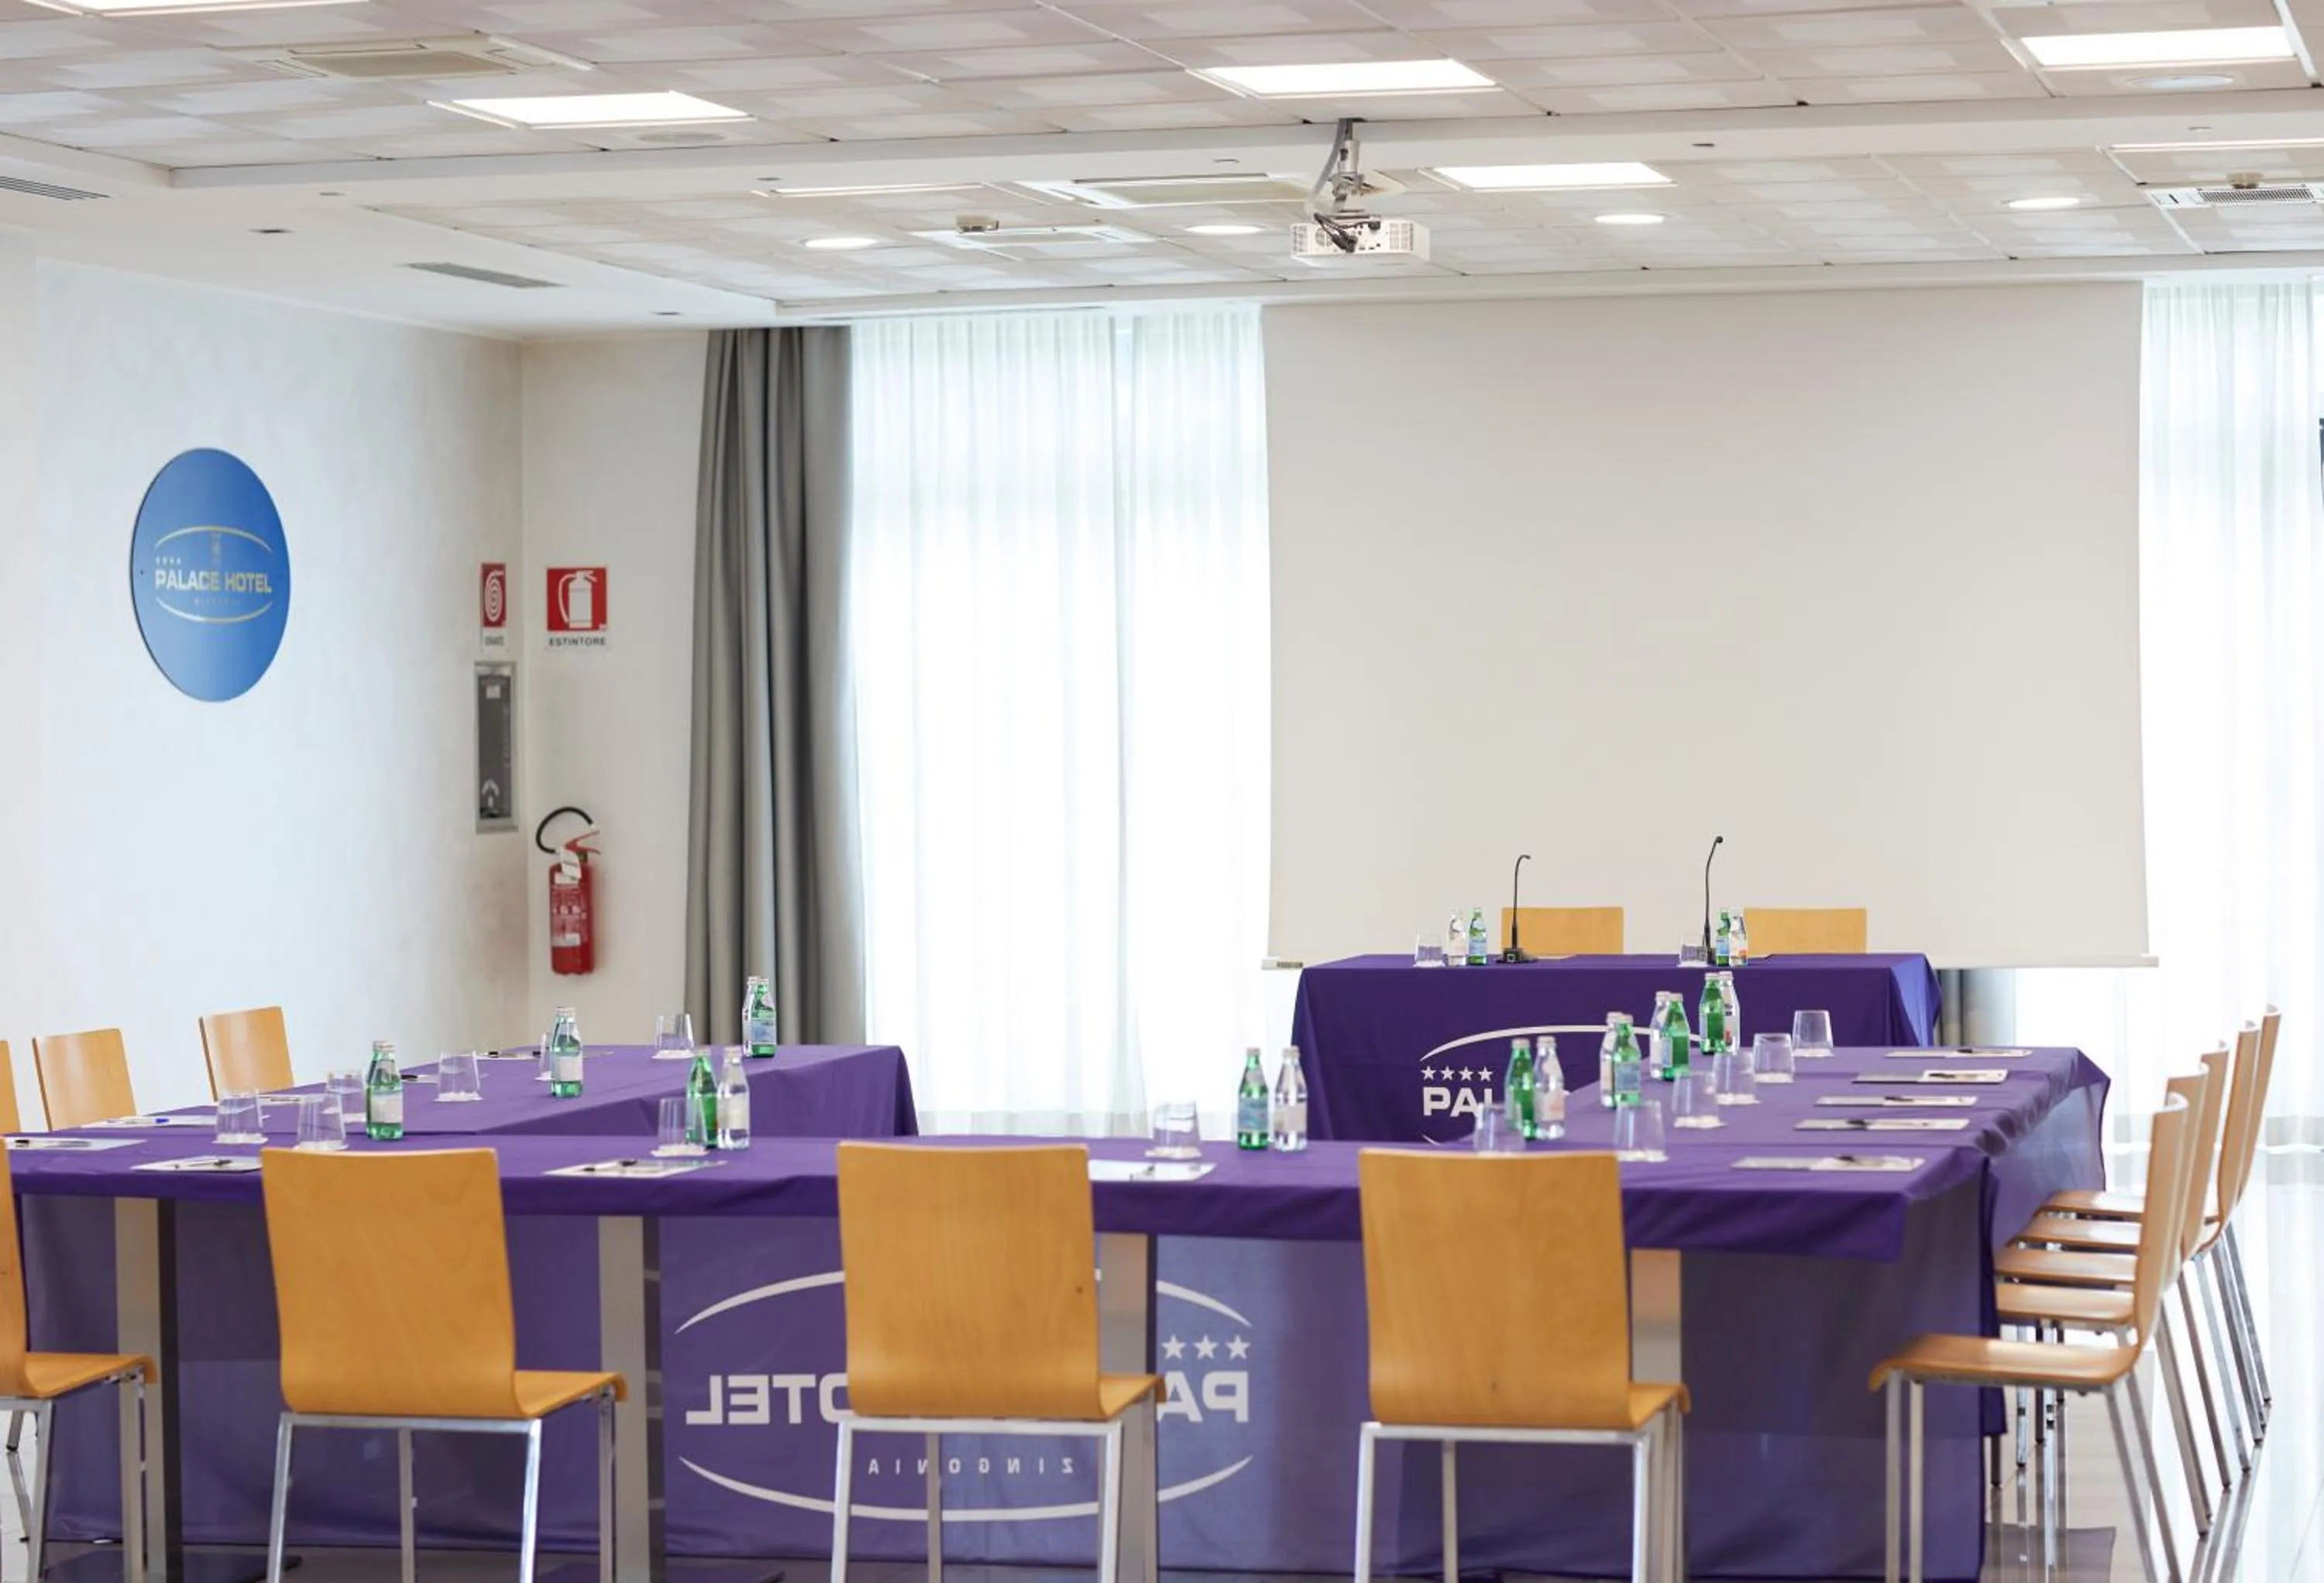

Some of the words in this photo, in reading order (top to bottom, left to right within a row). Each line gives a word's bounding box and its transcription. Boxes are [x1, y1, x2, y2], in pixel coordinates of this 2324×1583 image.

[155, 568, 221, 592] PALACE
[225, 572, 273, 593] HOTEL
[548, 637, 607, 646] ESTINTORE
